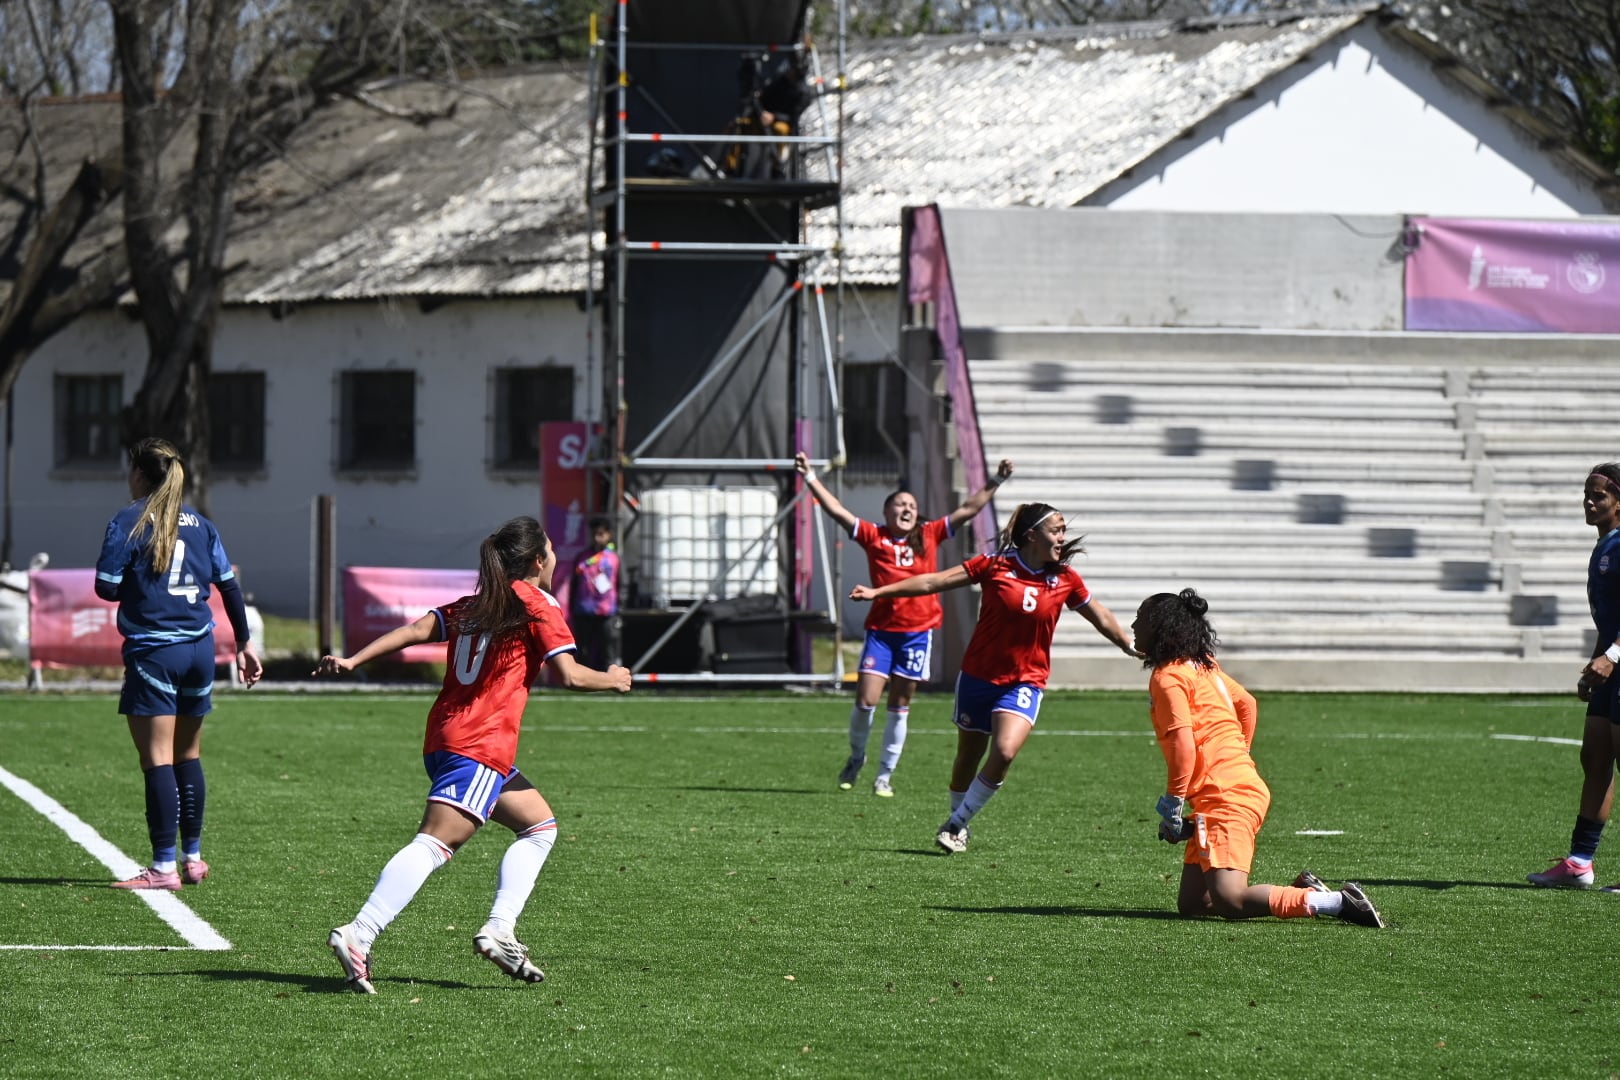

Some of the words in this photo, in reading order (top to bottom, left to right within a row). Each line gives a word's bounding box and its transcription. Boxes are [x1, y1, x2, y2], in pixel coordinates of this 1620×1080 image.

[893, 543, 914, 567] 13
[167, 539, 200, 604] 4
[1022, 586, 1039, 613] 6
[905, 647, 926, 673] 13
[1016, 686, 1032, 709] 6
